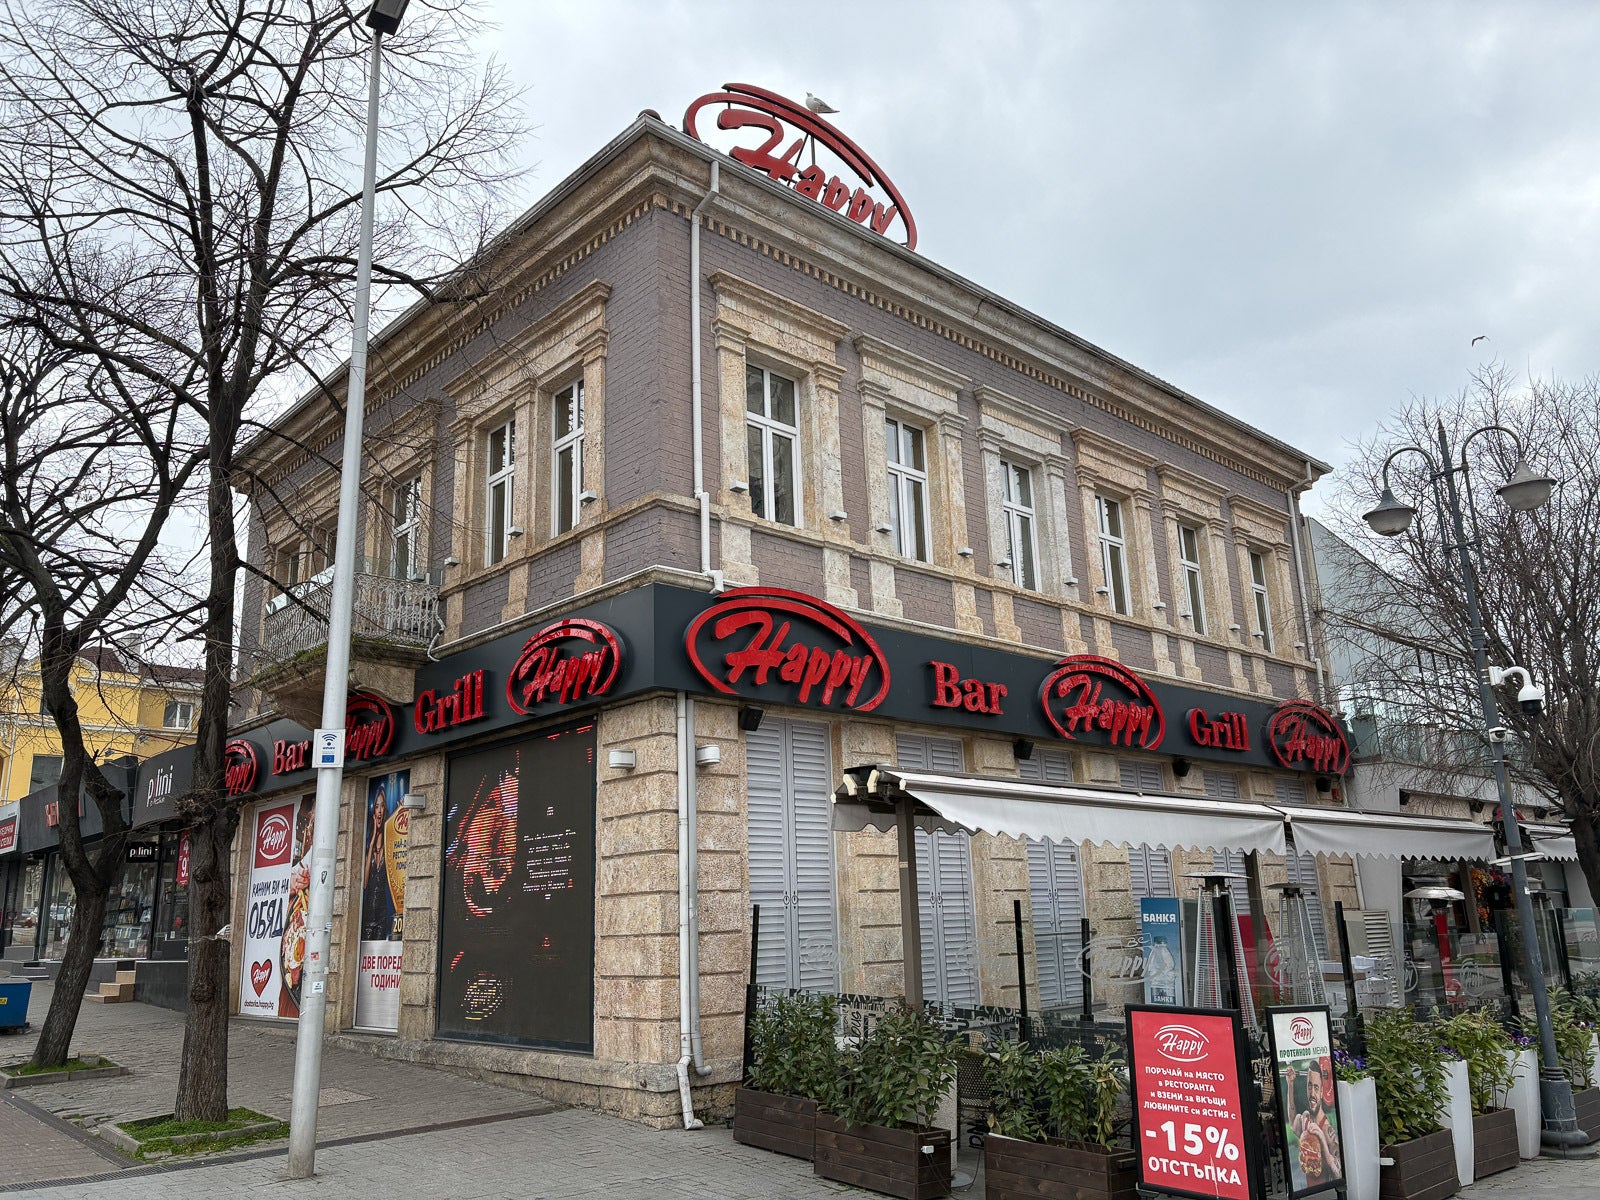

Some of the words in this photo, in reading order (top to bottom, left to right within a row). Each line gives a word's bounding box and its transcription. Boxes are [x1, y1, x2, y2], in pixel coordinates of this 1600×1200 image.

[717, 108, 898, 235] Happy
[714, 610, 874, 707] Happy
[521, 646, 608, 708] Happy
[930, 660, 1008, 716] Bar
[413, 669, 485, 735] Grill
[1057, 673, 1154, 747] Happy
[1189, 707, 1252, 752] Grill
[1279, 715, 1342, 773] Happy
[272, 739, 309, 775] Bar
[261, 826, 287, 850] Happy
[281, 878, 289, 895] НА
[249, 897, 283, 939] ОБЯД
[1142, 913, 1176, 923] БАНКЯ
[361, 956, 376, 972] ДВЕ
[1159, 1033, 1205, 1055] Happy
[1292, 1023, 1312, 1041] Happy
[1312, 1046, 1328, 1055] МЕНЮ
[1145, 1066, 1182, 1077] ПОРЪЧАЙ
[1196, 1072, 1225, 1081] МЯСТО
[1164, 1080, 1216, 1093] РЕСТОРАНТА
[1143, 1101, 1189, 1113] ЛЮБИМИТЕ
[1202, 1108, 1229, 1119] ЯСТИЯ
[1157, 1091, 1183, 1101] ВЗЕМИ
[1196, 1095, 1227, 1107] ВКЪЩИ
[1145, 1120, 1239, 1161] -15%
[1148, 1156, 1242, 1186] ОТСТЪПКА
